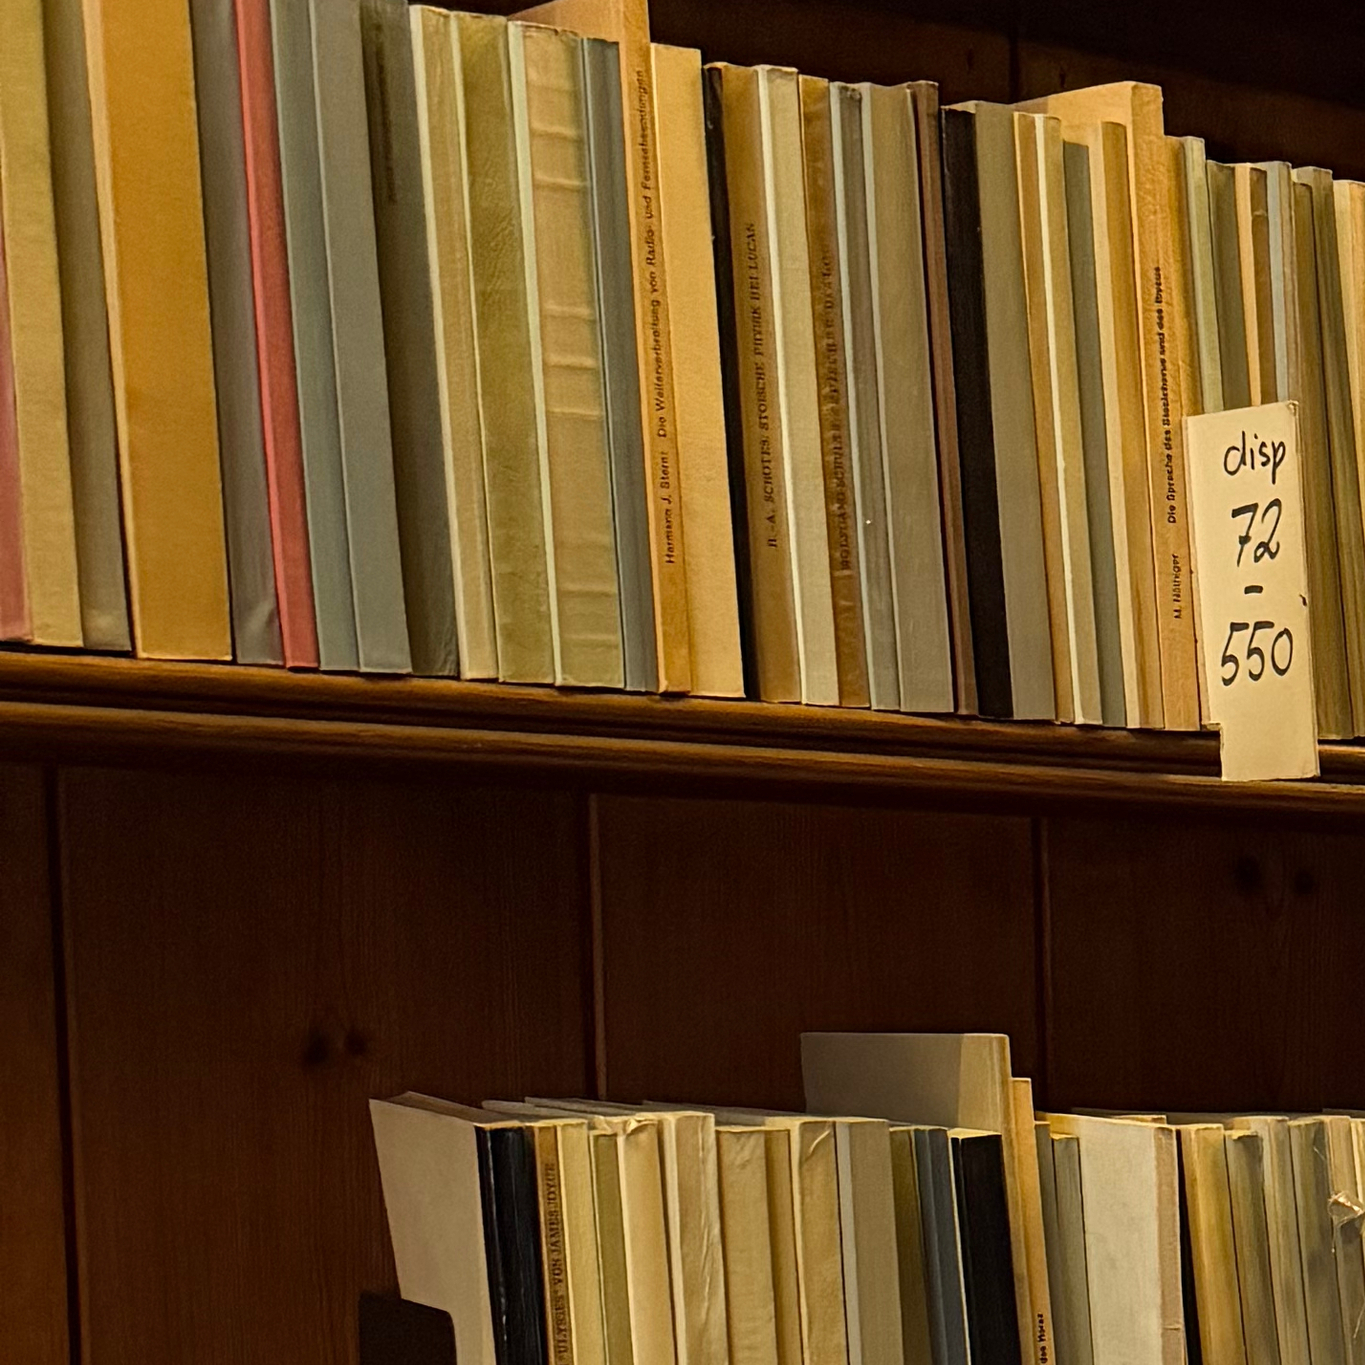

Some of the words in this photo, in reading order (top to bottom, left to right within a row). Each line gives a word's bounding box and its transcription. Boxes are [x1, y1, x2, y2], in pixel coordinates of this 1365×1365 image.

[640, 195, 652, 219] und
[647, 271, 657, 293] von
[656, 417, 666, 437] Die
[1162, 429, 1172, 450] des
[1223, 430, 1286, 485] disp
[1166, 504, 1176, 523] Die
[1231, 498, 1282, 567] 72
[1221, 620, 1293, 687] 550
[1038, 1345, 1047, 1363] des
